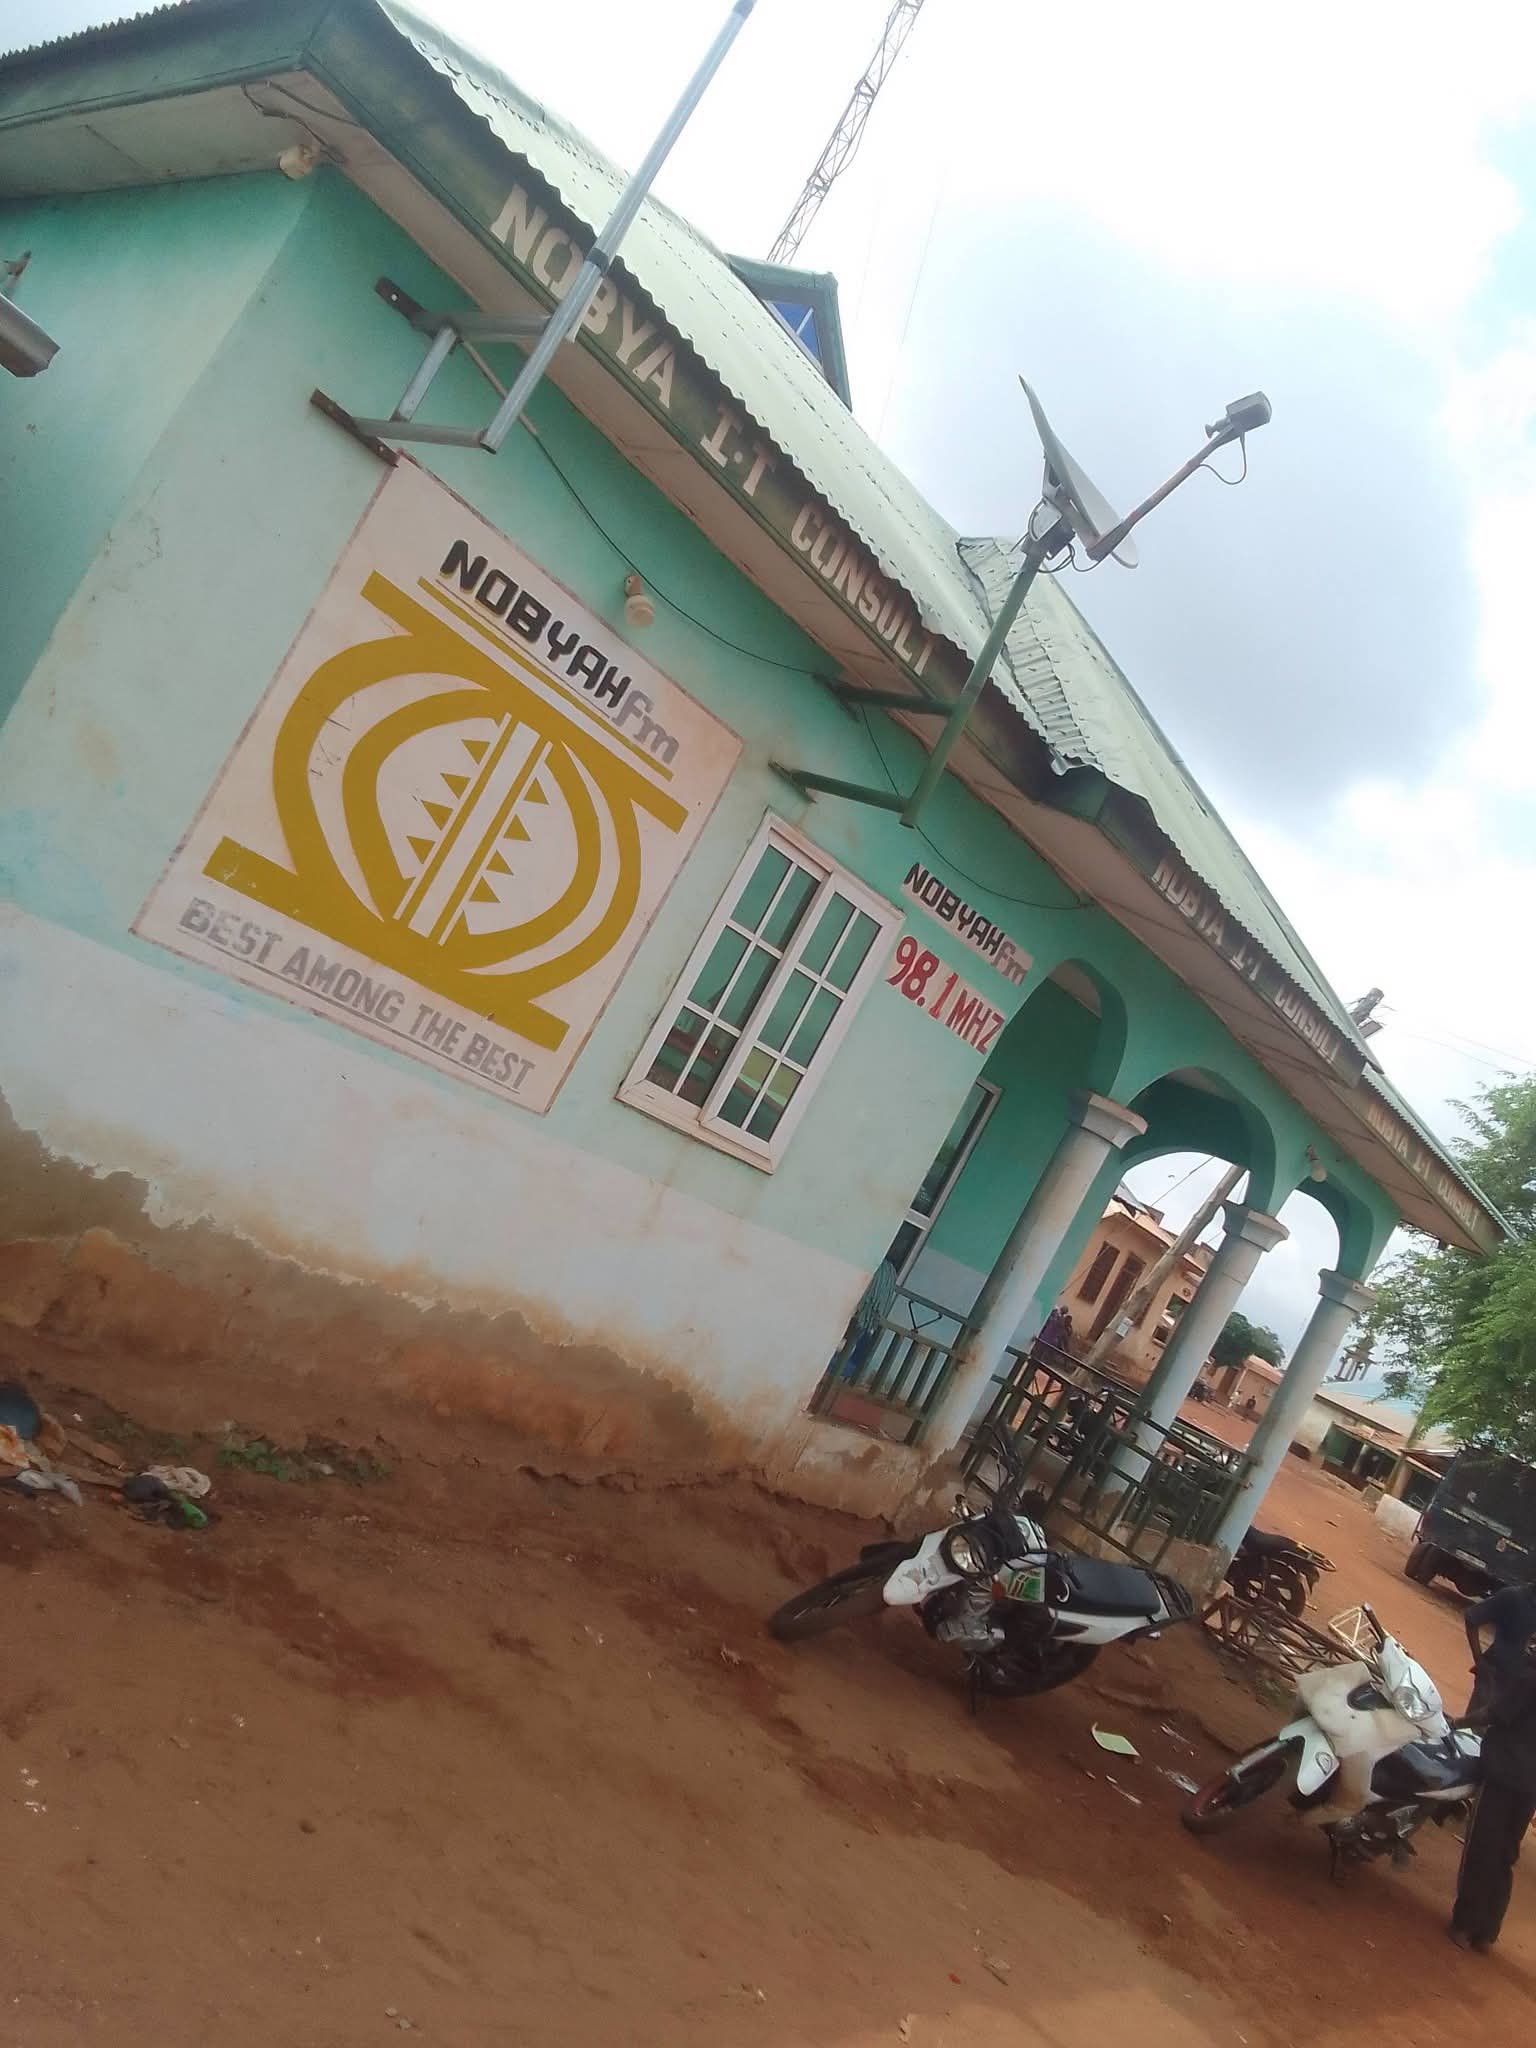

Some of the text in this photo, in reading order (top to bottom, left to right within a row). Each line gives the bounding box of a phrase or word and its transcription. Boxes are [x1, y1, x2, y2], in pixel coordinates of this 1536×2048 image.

[490, 184, 676, 408] NOBYA
[791, 503, 936, 677] CONSULT
[178, 897, 536, 1089] BEST AMONG THE BEST
[886, 935, 959, 1020] 98.1
